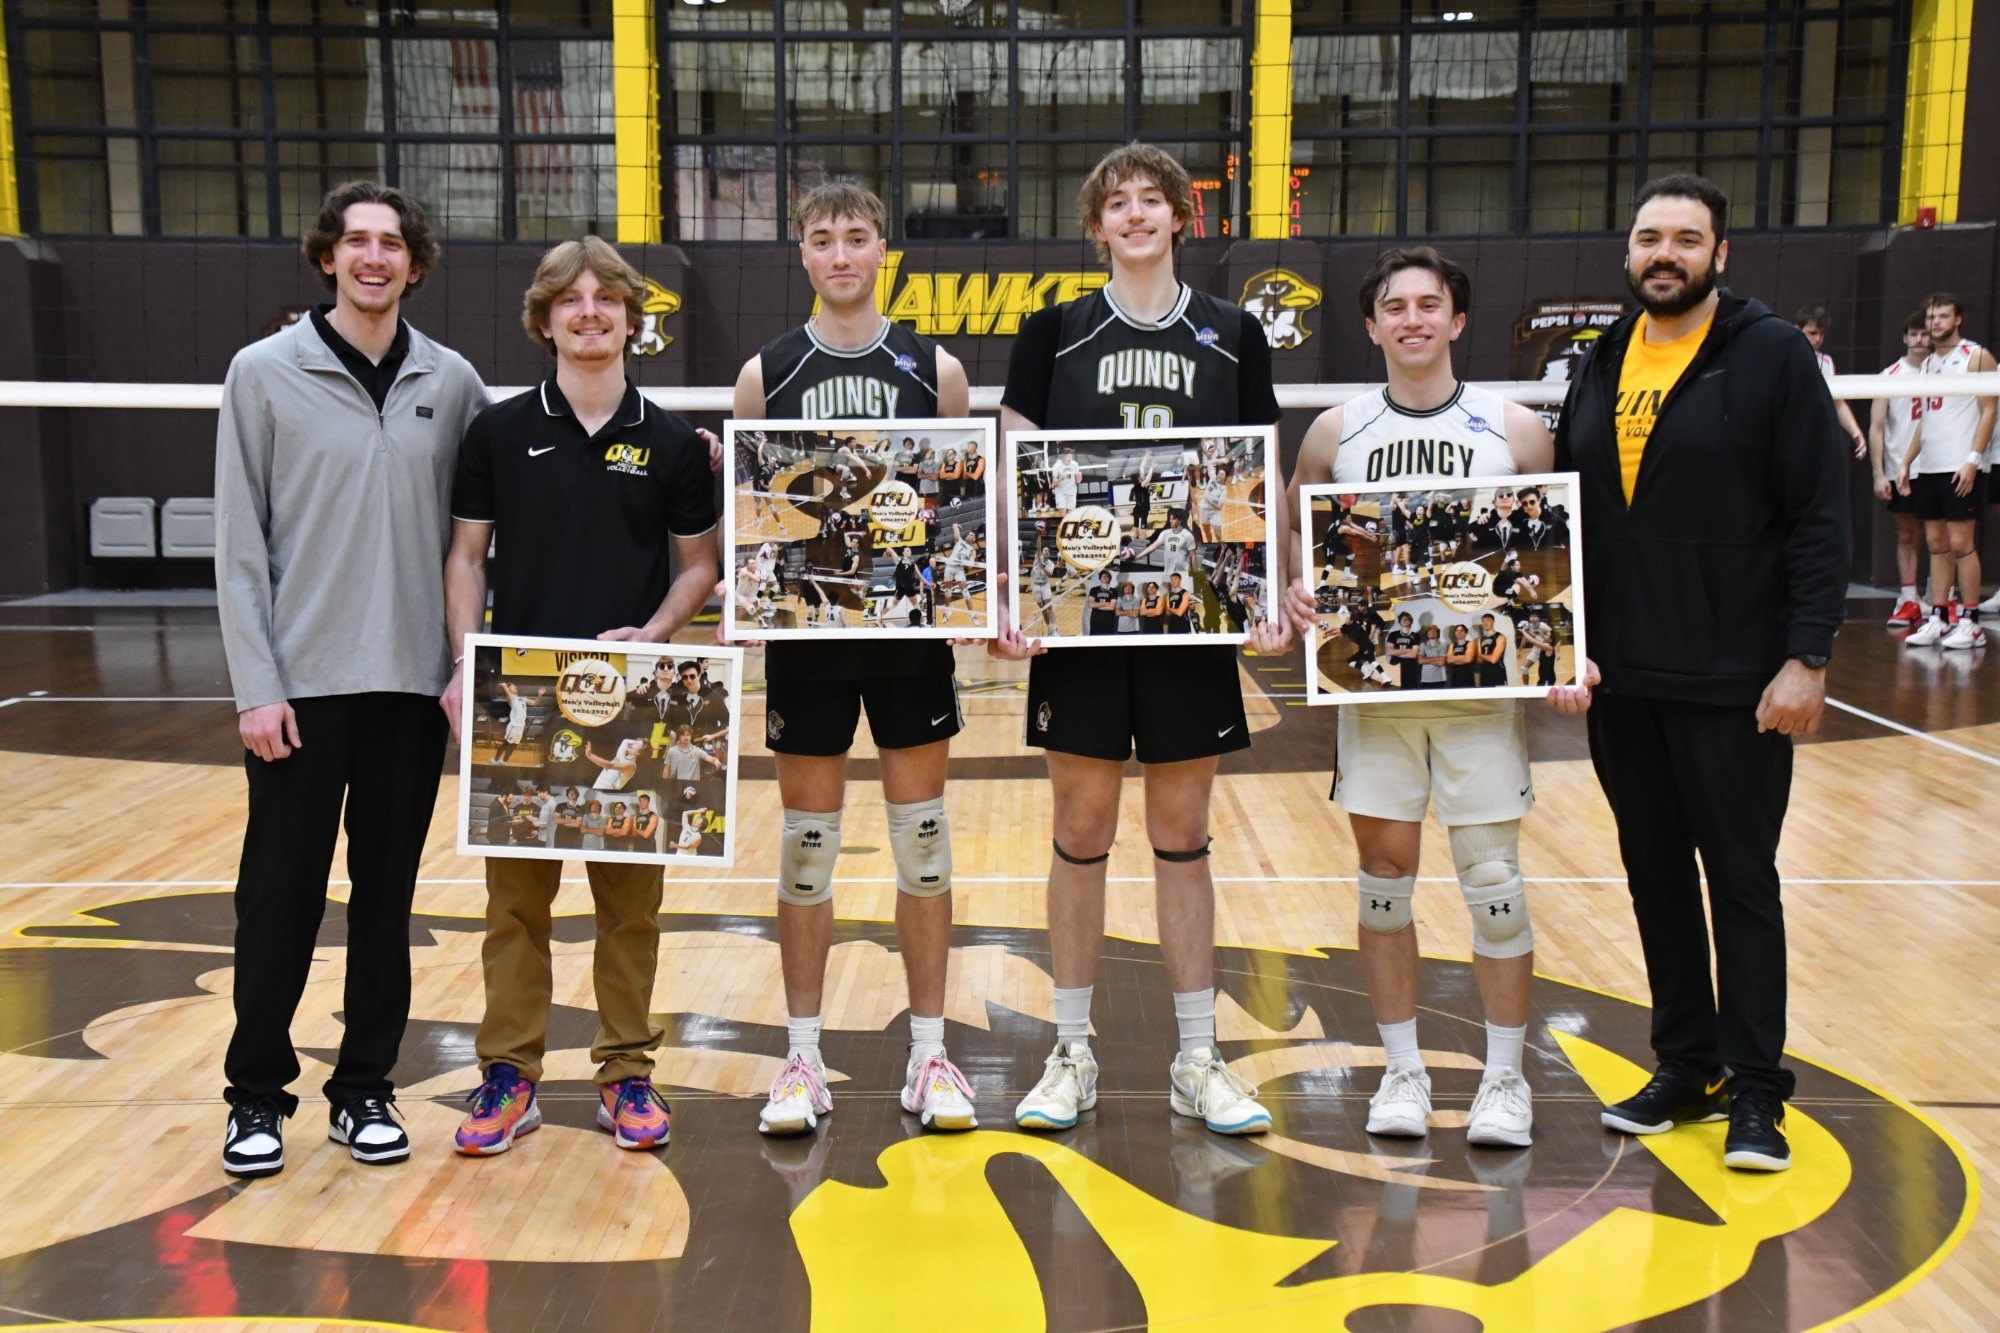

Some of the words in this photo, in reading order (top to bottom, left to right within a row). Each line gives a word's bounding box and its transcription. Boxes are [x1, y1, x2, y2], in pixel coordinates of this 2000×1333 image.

[1531, 315, 1569, 329] PEPSI
[1589, 314, 1619, 326] ARE
[1097, 348, 1196, 399] QUINCY
[801, 375, 900, 419] QUINCY
[1366, 439, 1475, 483] QUINCY
[606, 465, 649, 476] VOLLEYBALL
[1059, 520, 1113, 541] QU
[1082, 544, 1117, 552] Volleyball
[560, 674, 619, 695] QU
[561, 698, 582, 706] Men's
[583, 699, 620, 708] Volleyball
[918, 828, 939, 838] errea
